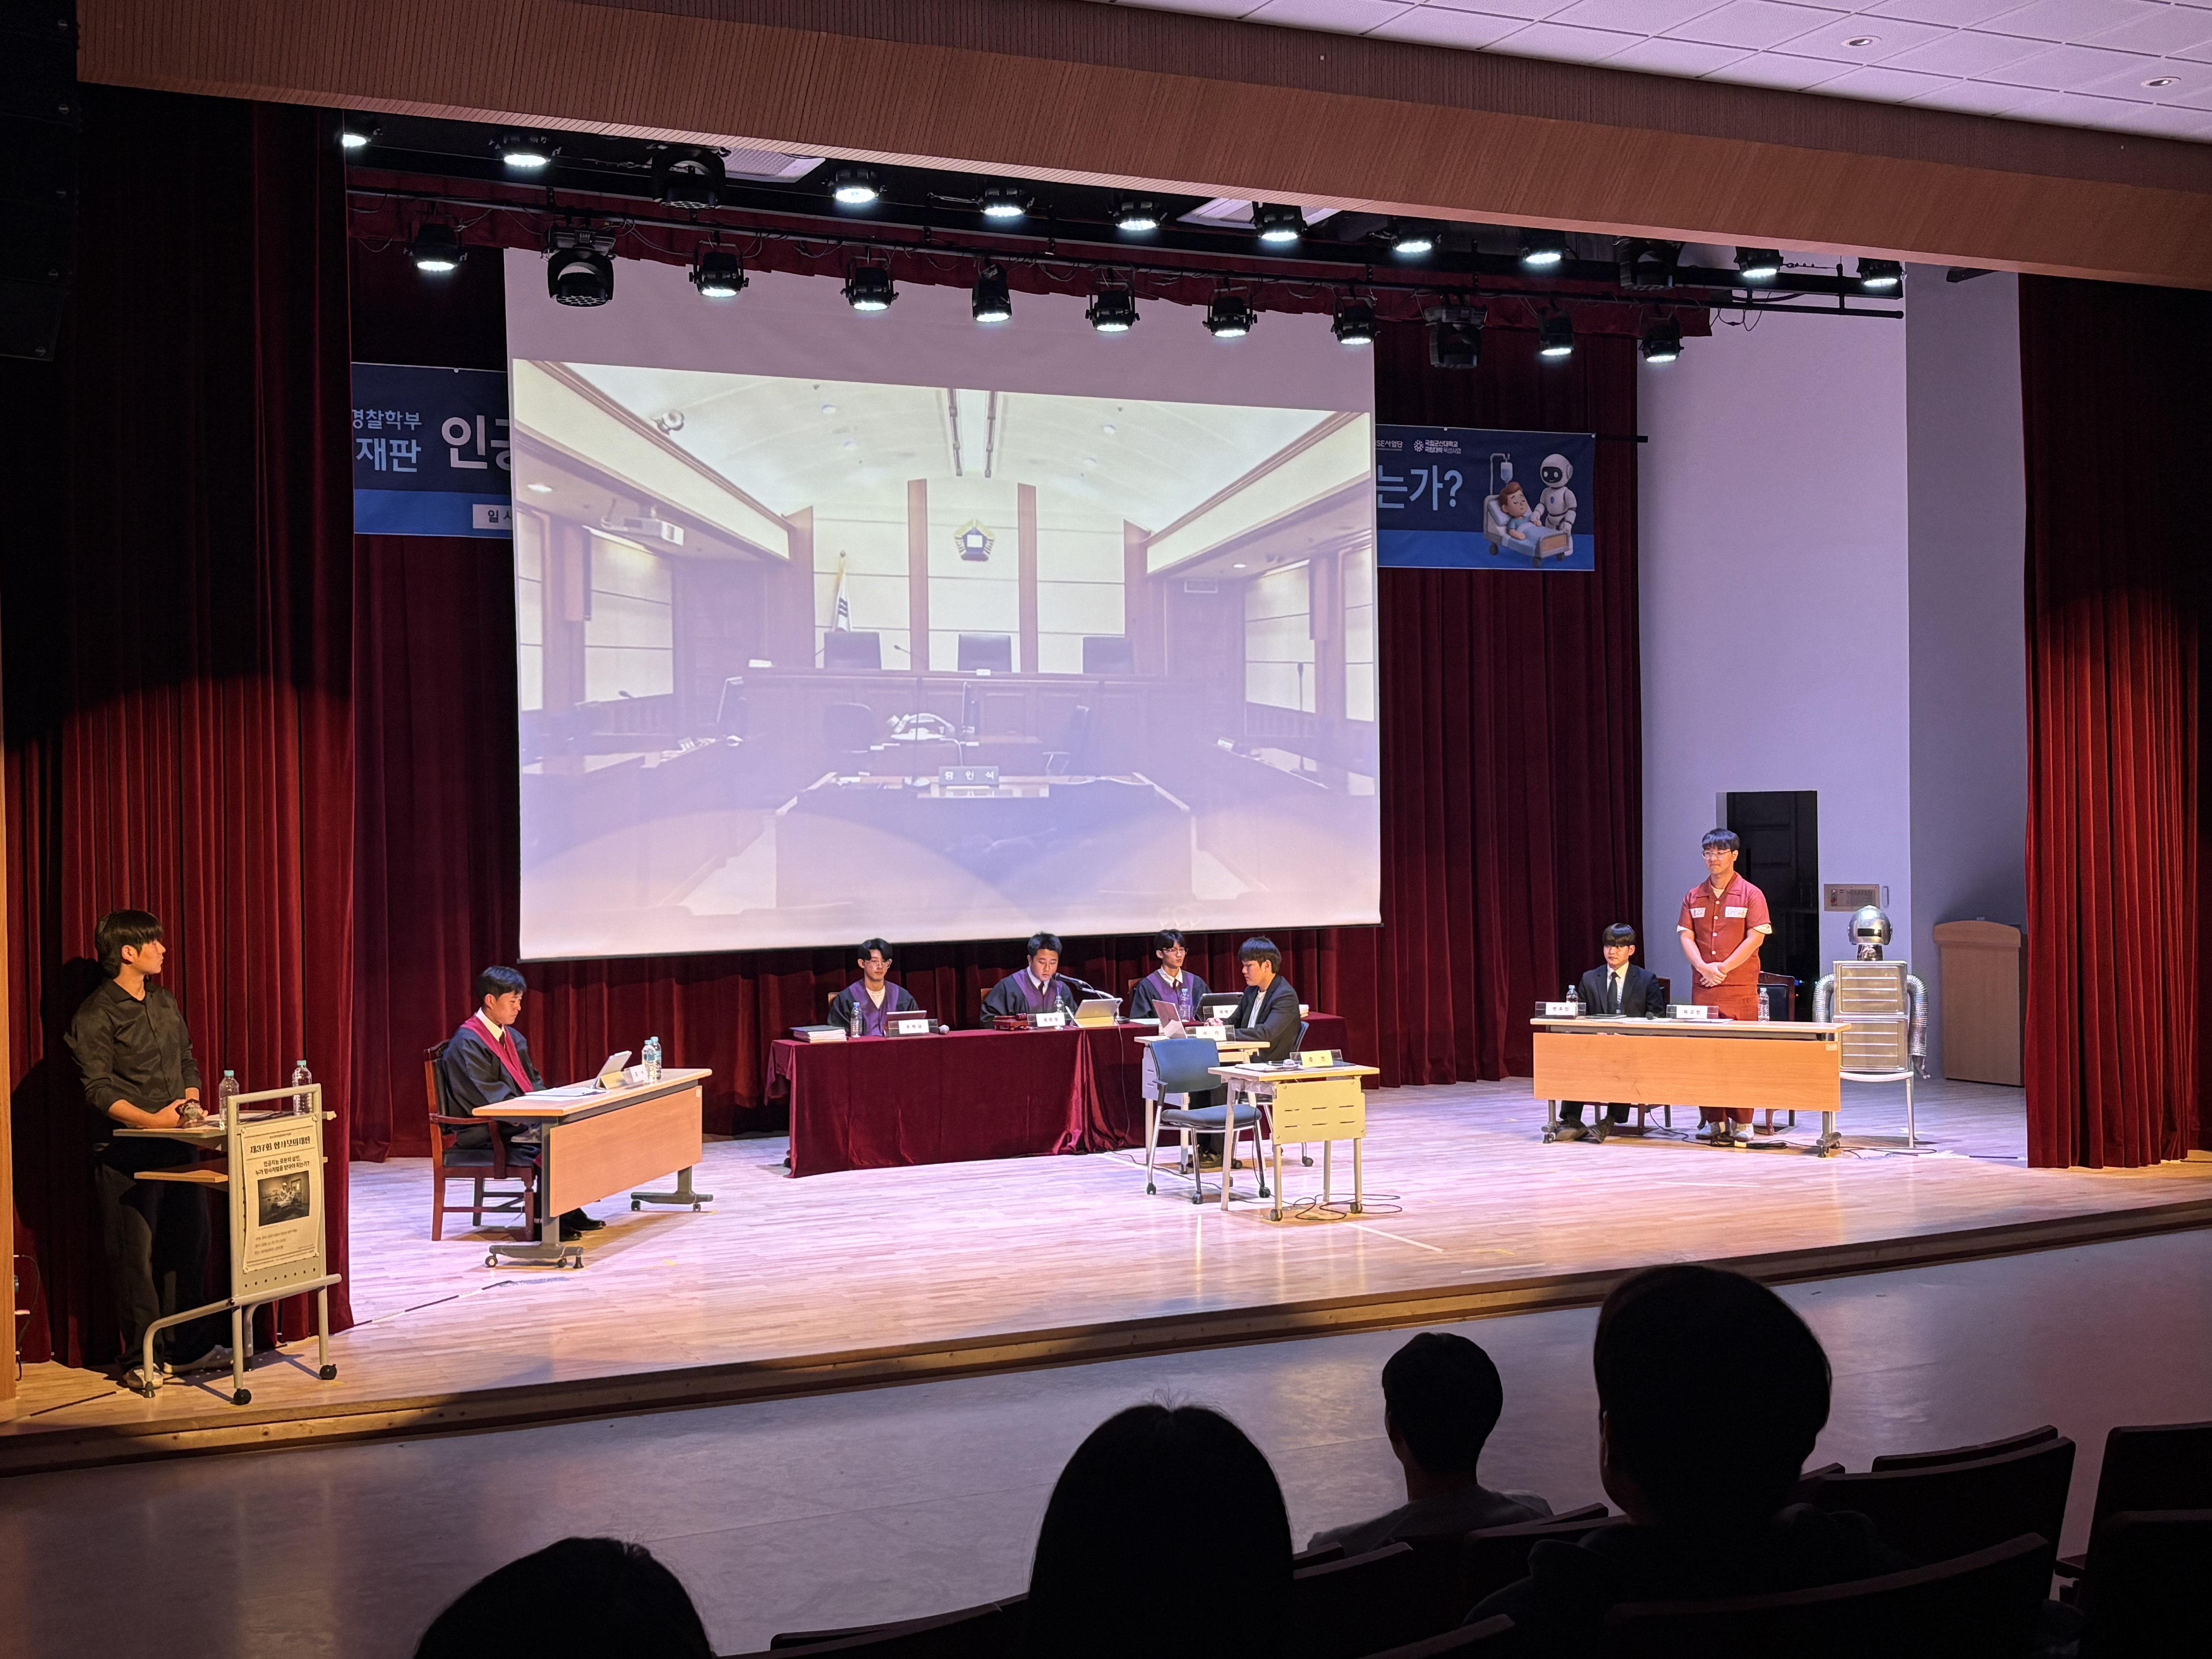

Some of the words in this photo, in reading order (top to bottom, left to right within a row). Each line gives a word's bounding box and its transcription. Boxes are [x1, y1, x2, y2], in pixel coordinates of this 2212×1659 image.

[352, 409, 422, 431] 경찰학부
[356, 438, 421, 472] 재판
[1376, 465, 1463, 510] 는가?
